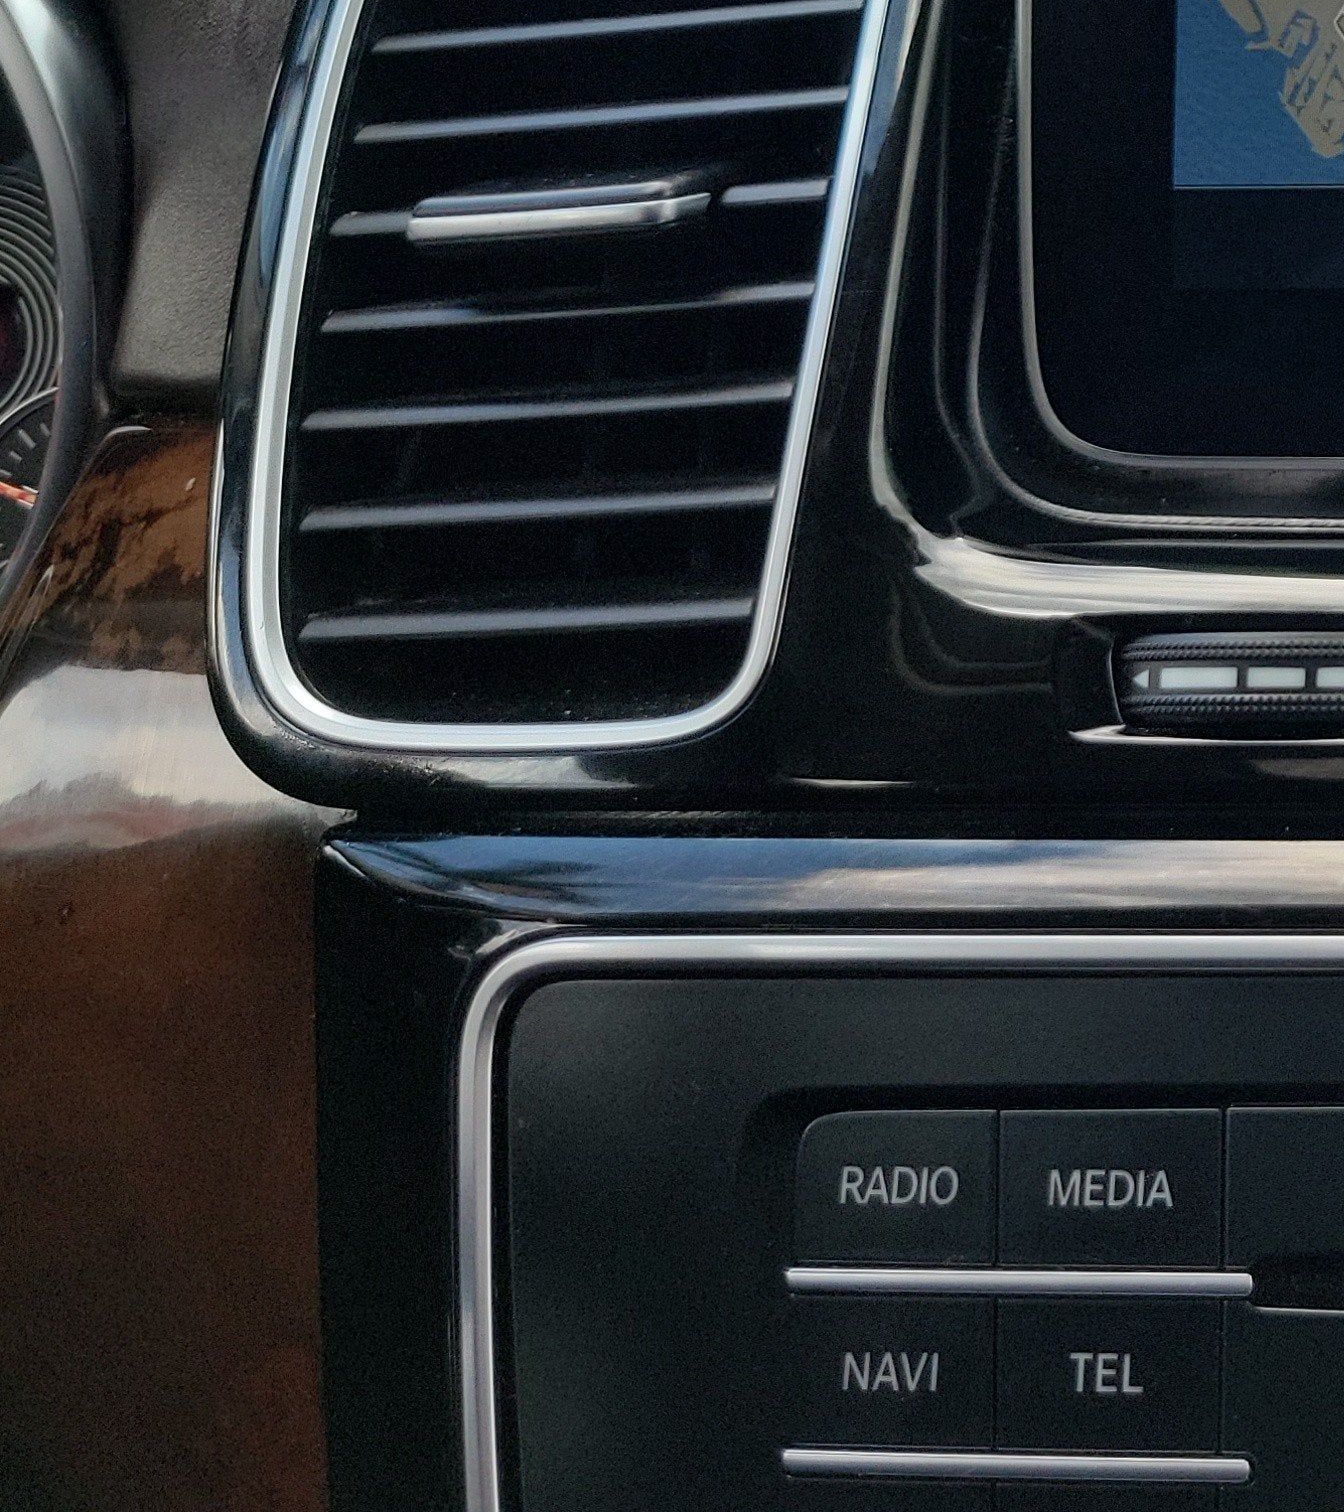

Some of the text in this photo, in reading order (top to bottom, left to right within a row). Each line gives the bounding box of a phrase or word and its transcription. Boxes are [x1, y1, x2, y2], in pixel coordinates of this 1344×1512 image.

[840, 1166, 959, 1205] RADIO
[1048, 1168, 1173, 1208] MEDIA
[842, 1352, 940, 1392] NAVI
[1070, 1352, 1143, 1393] TEL
